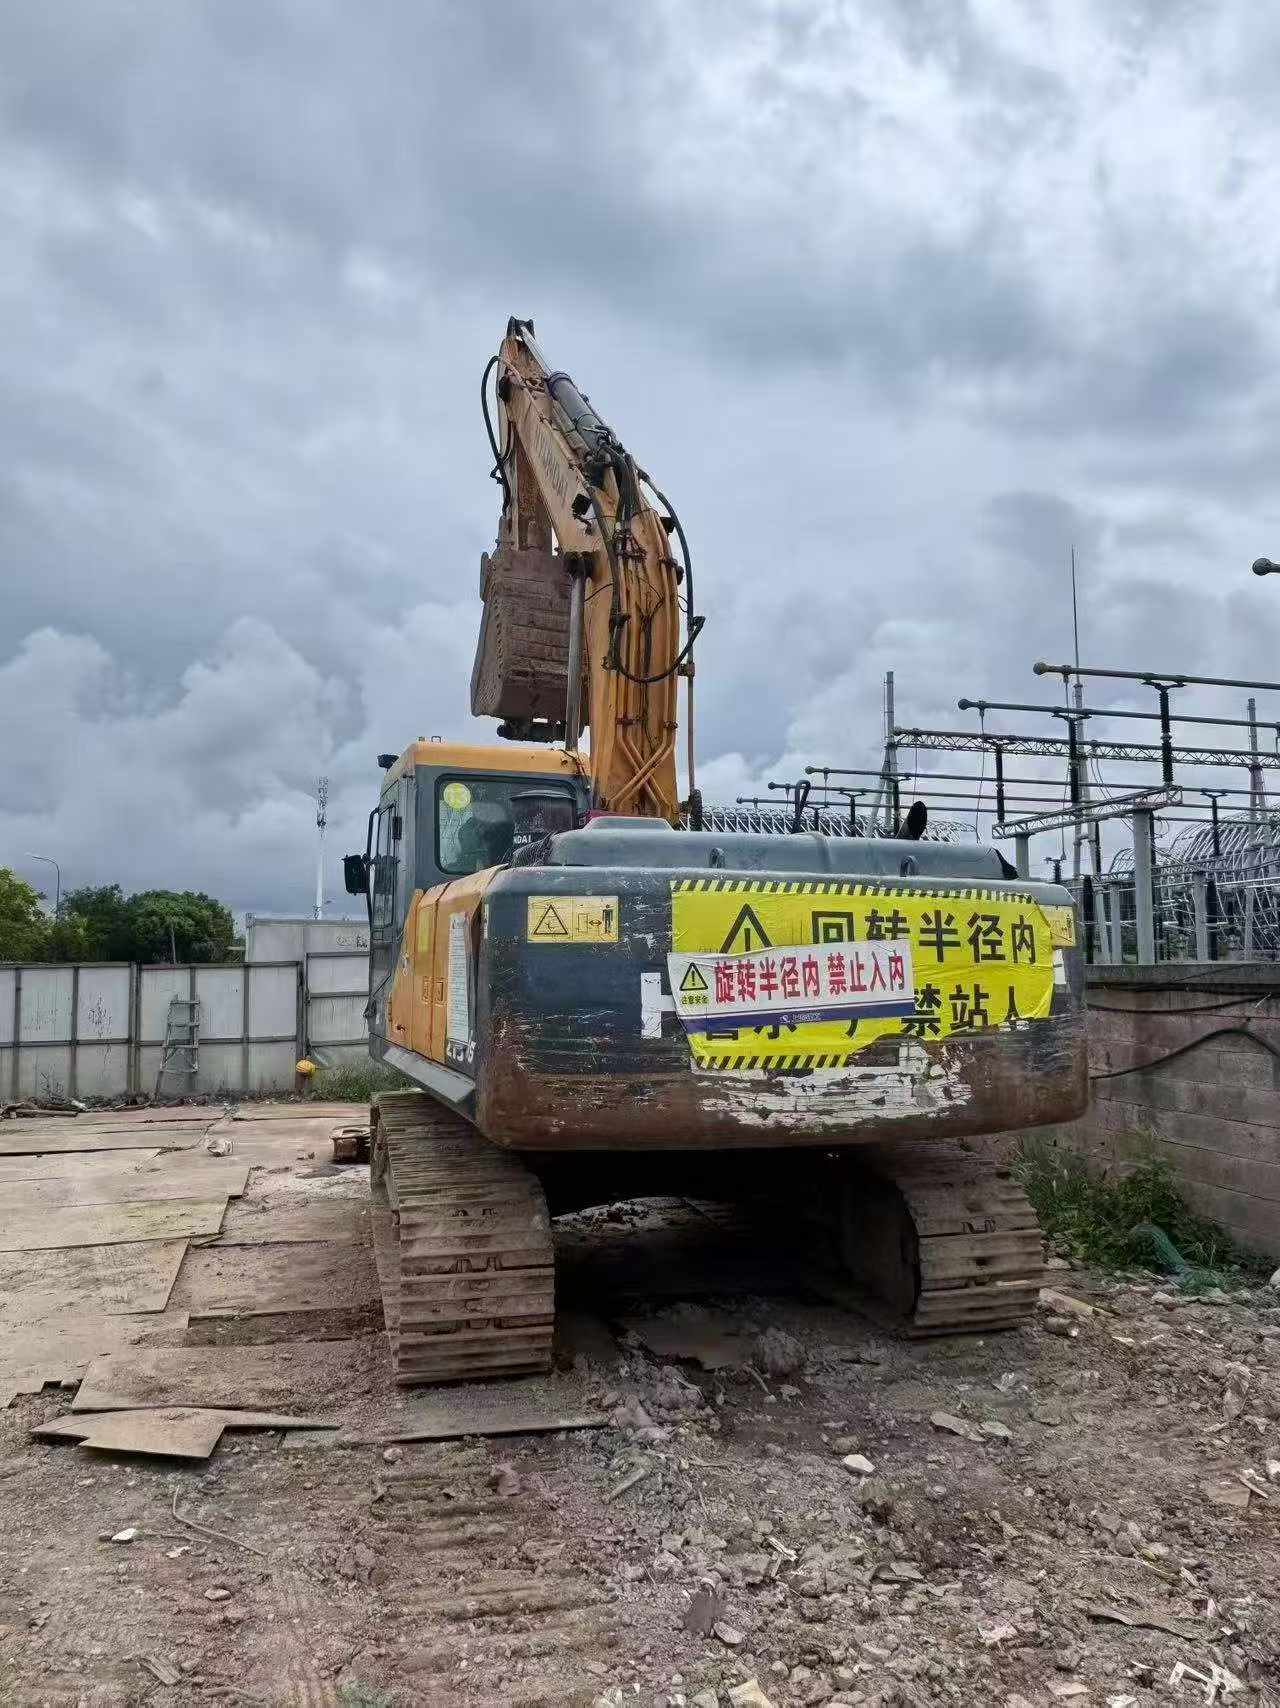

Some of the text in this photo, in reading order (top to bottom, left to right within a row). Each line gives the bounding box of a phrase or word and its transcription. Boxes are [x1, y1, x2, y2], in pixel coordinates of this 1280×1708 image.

[714, 950, 904, 1003] 旋转半径内 禁止入内
